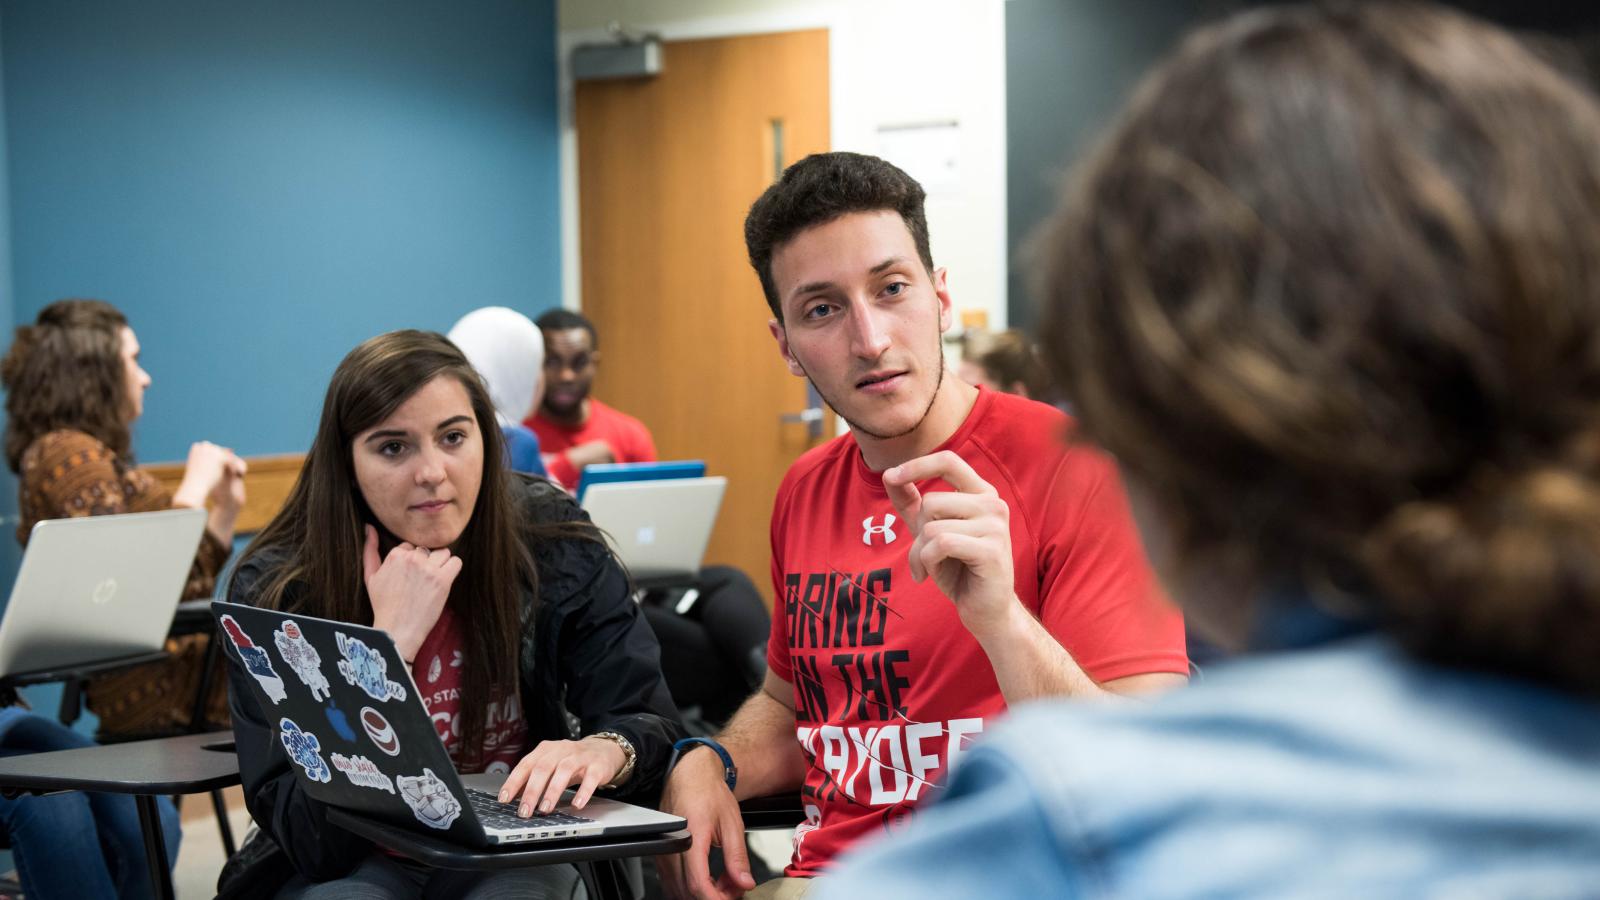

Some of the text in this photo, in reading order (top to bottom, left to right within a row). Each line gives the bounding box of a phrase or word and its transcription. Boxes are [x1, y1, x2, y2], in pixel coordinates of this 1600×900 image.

[433, 688, 462, 704] STA
[831, 650, 911, 721] THE
[797, 717, 984, 806] AYOFF
